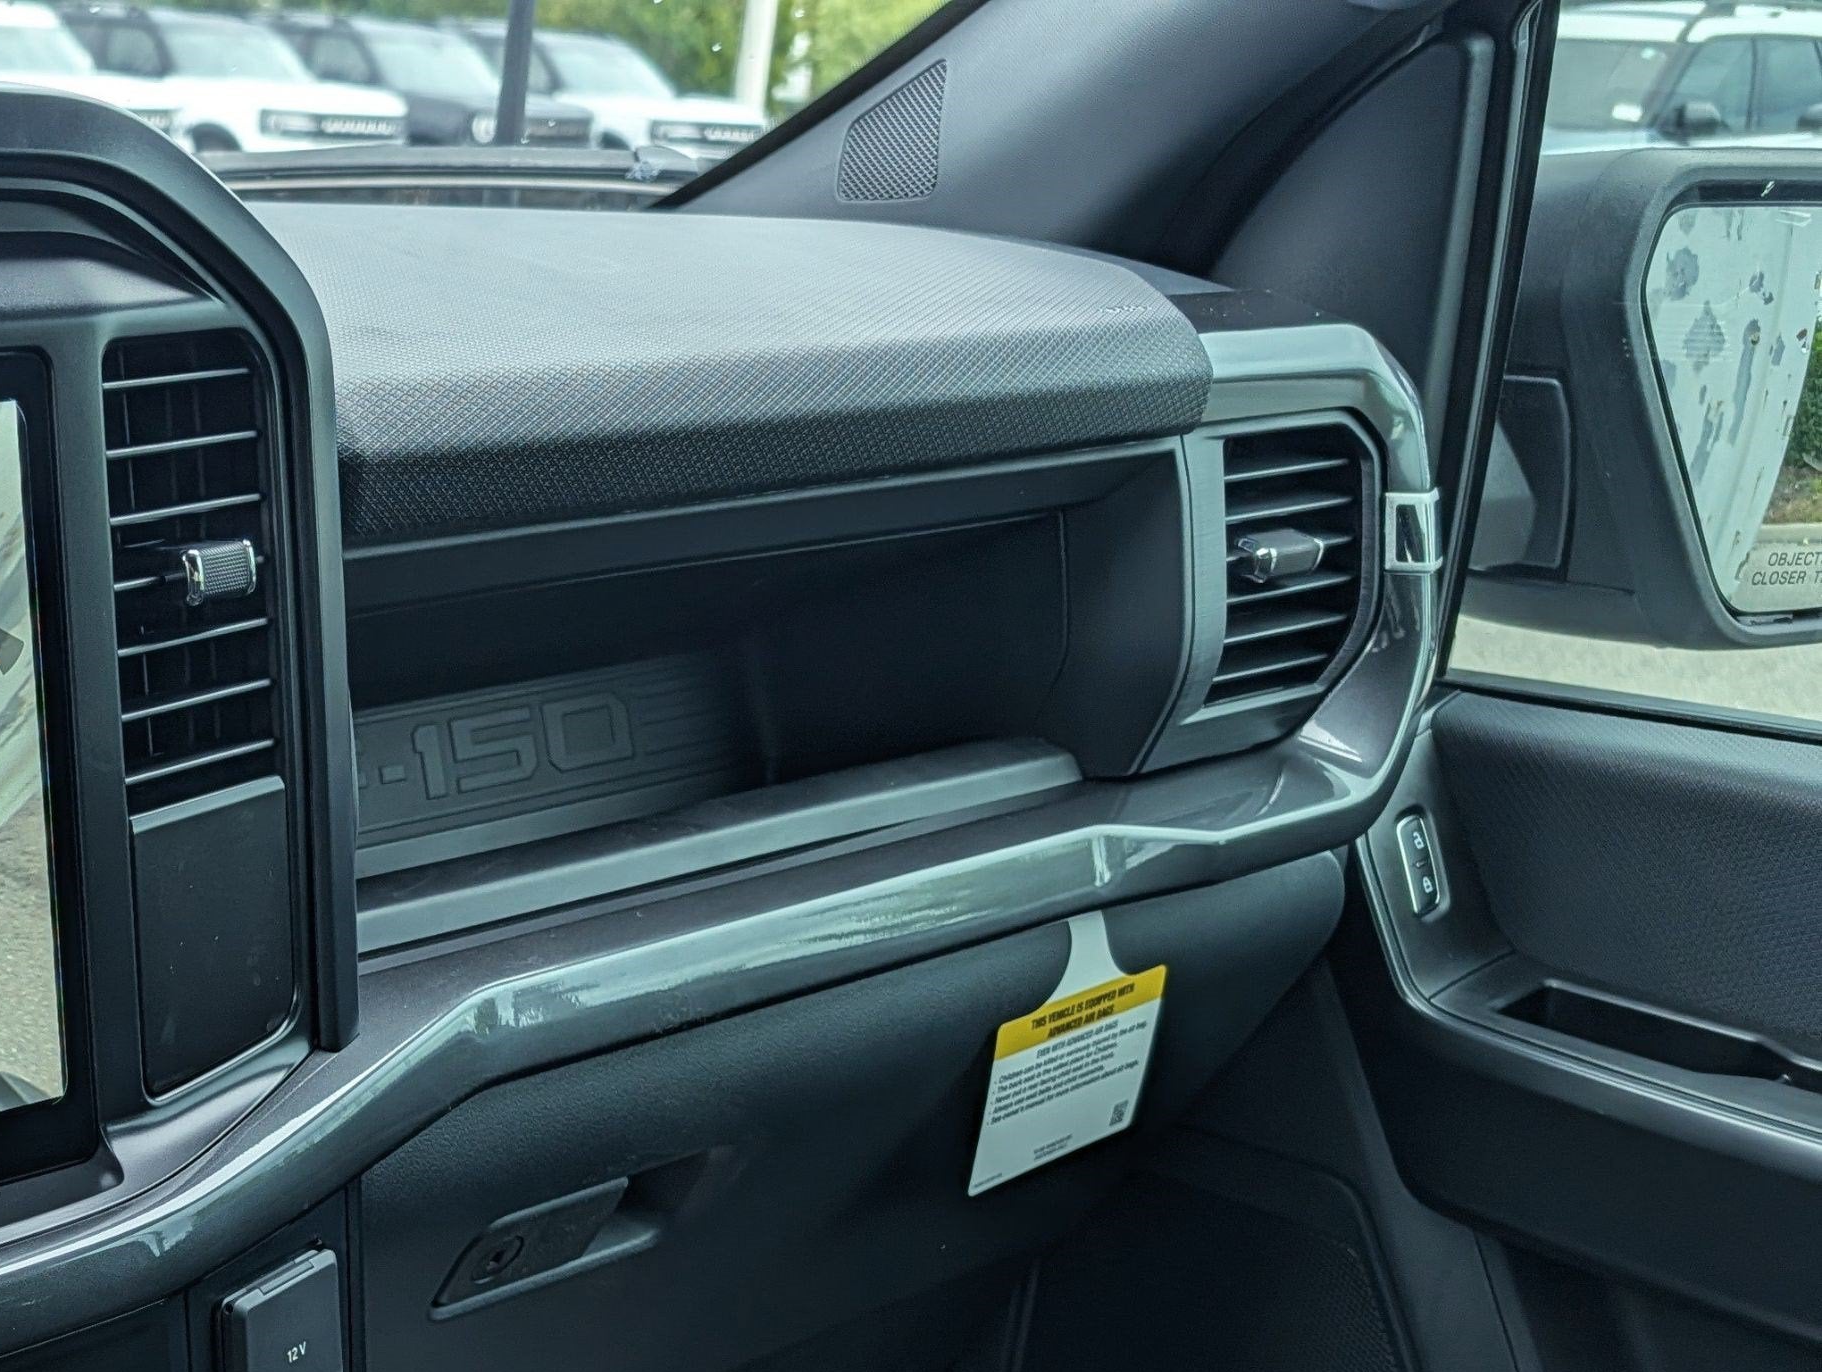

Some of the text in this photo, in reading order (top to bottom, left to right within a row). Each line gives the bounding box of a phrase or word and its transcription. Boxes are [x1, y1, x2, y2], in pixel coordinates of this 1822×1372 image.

[1768, 551, 1822, 566] OBJECT
[1751, 570, 1806, 585] CLOSER
[357, 693, 635, 800] -150
[1031, 1014, 1048, 1029] THIS
[1048, 1004, 1076, 1023] VEHICLE
[1076, 1001, 1083, 1012] IS
